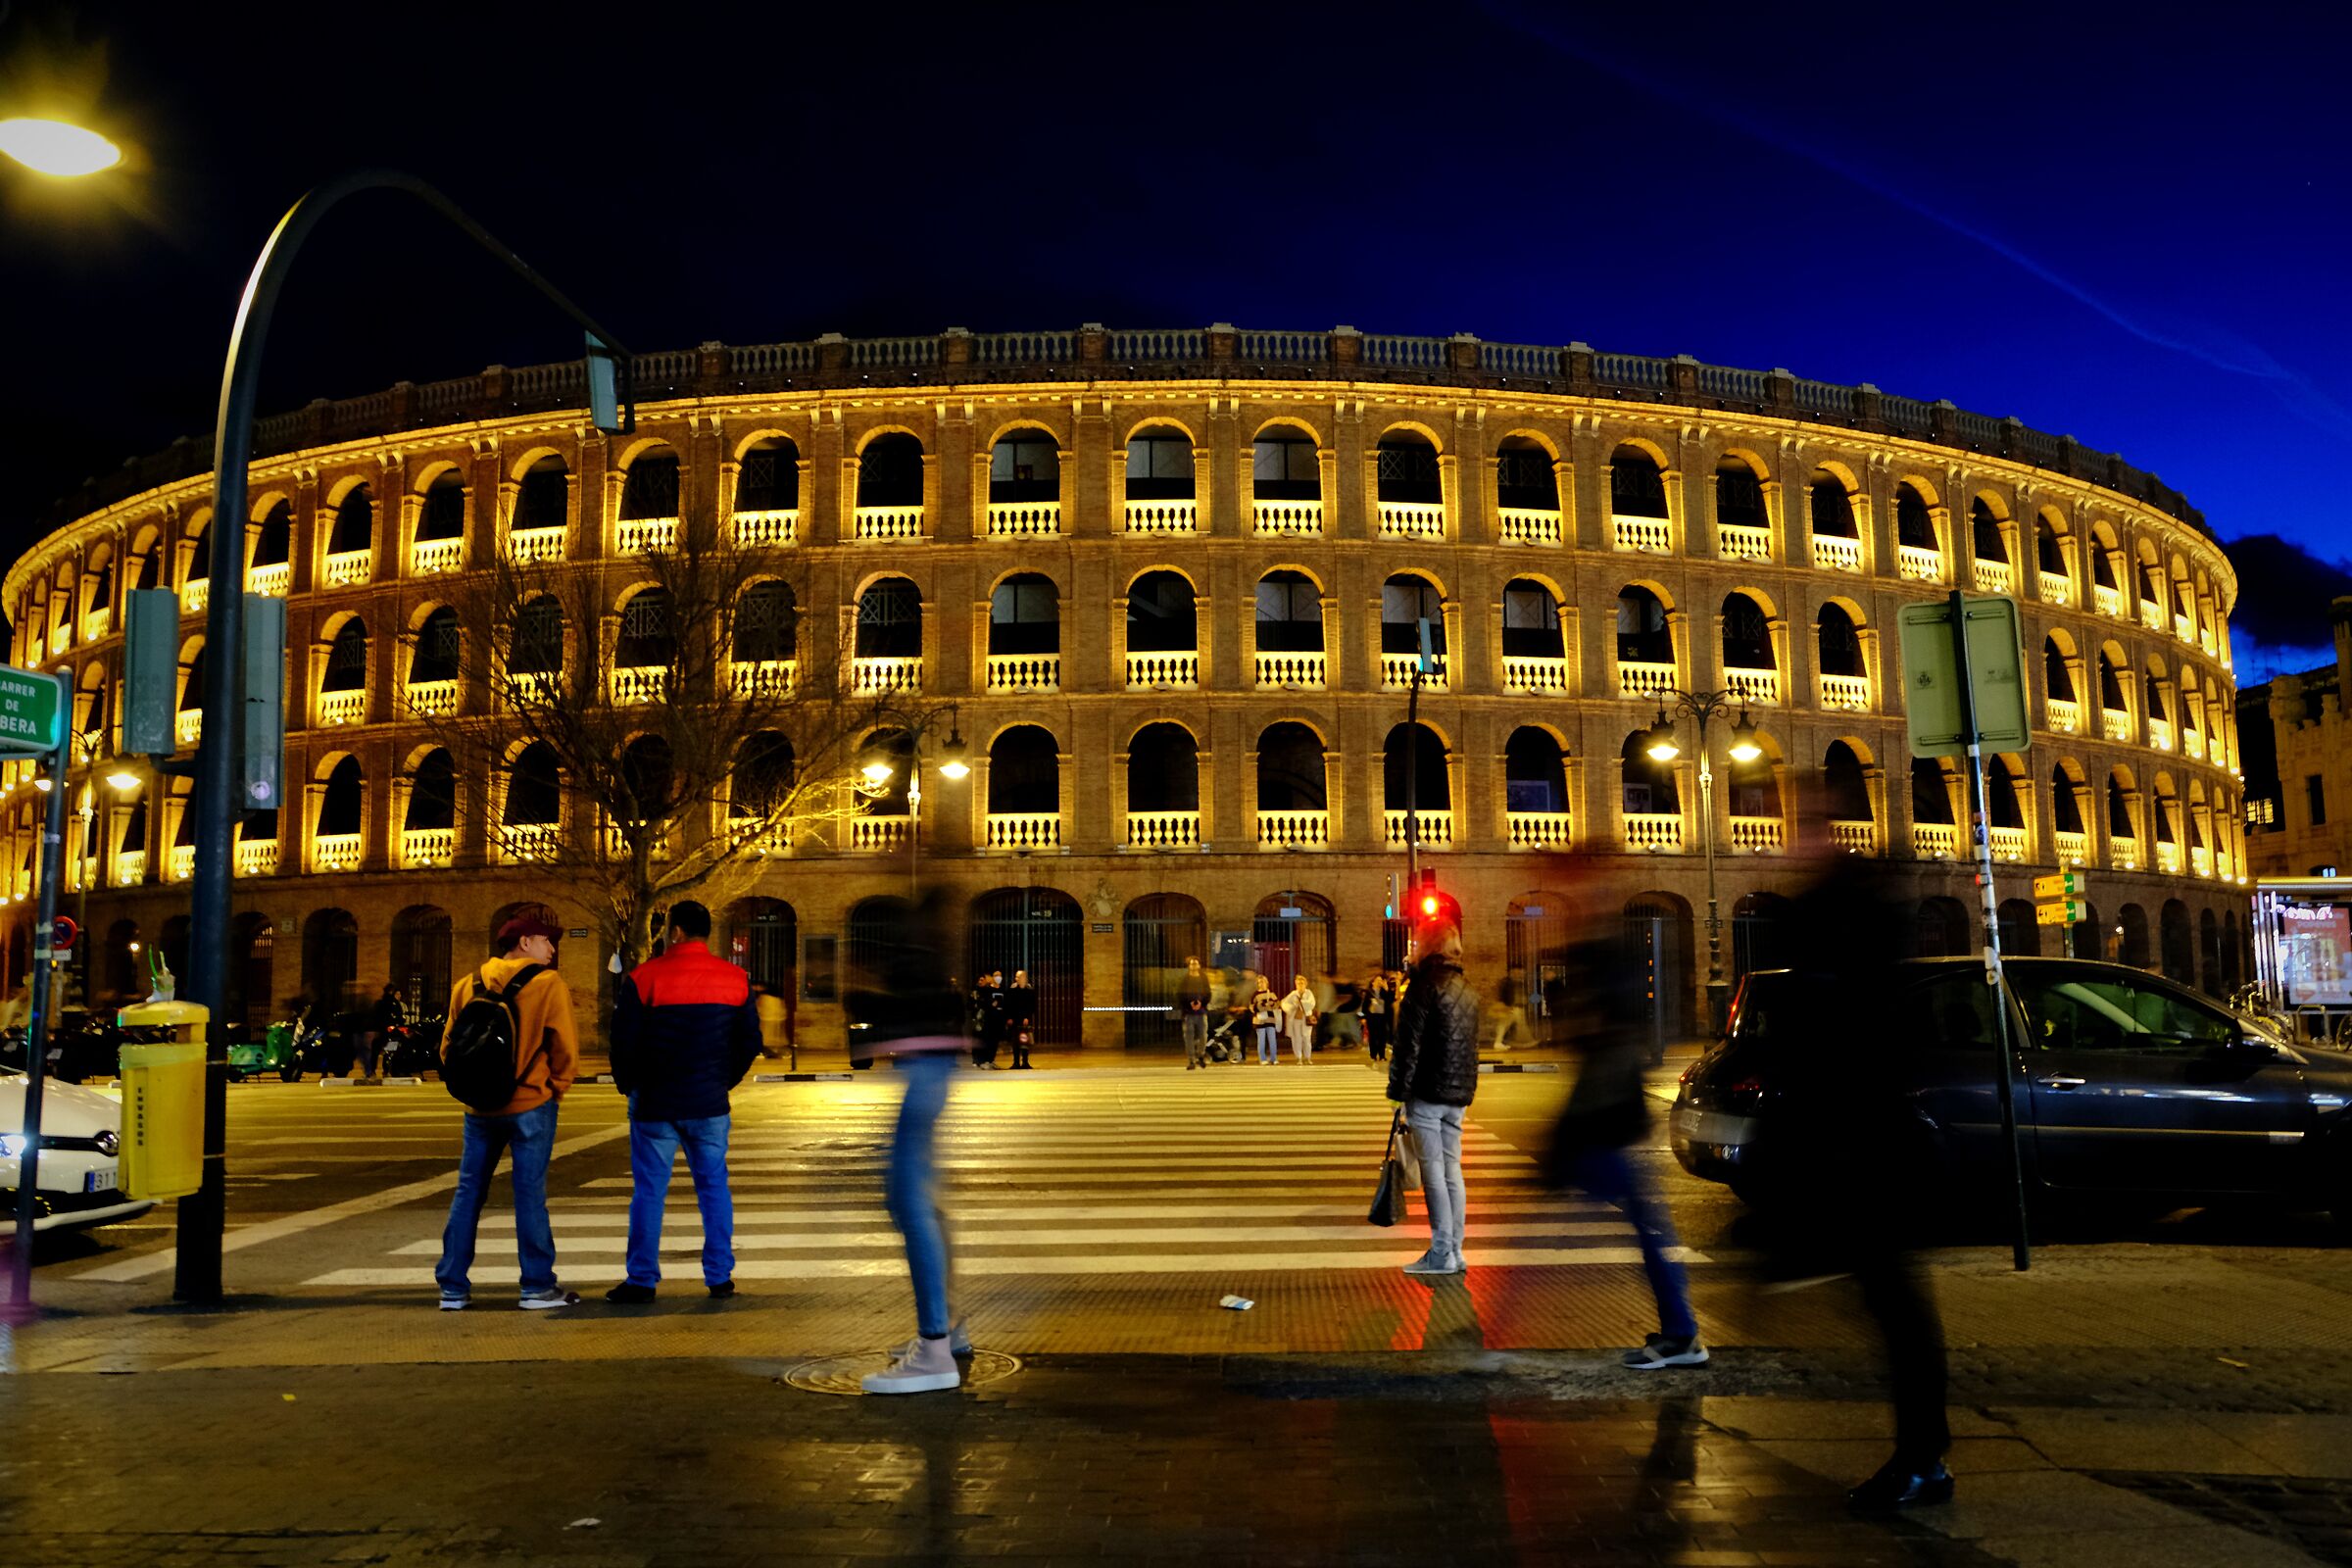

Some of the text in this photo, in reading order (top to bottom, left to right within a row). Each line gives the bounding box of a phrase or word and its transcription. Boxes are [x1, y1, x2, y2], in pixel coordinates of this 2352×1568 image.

[0, 680, 36, 698] ARRER
[5, 698, 20, 712] DE
[0, 714, 37, 736] BERA
